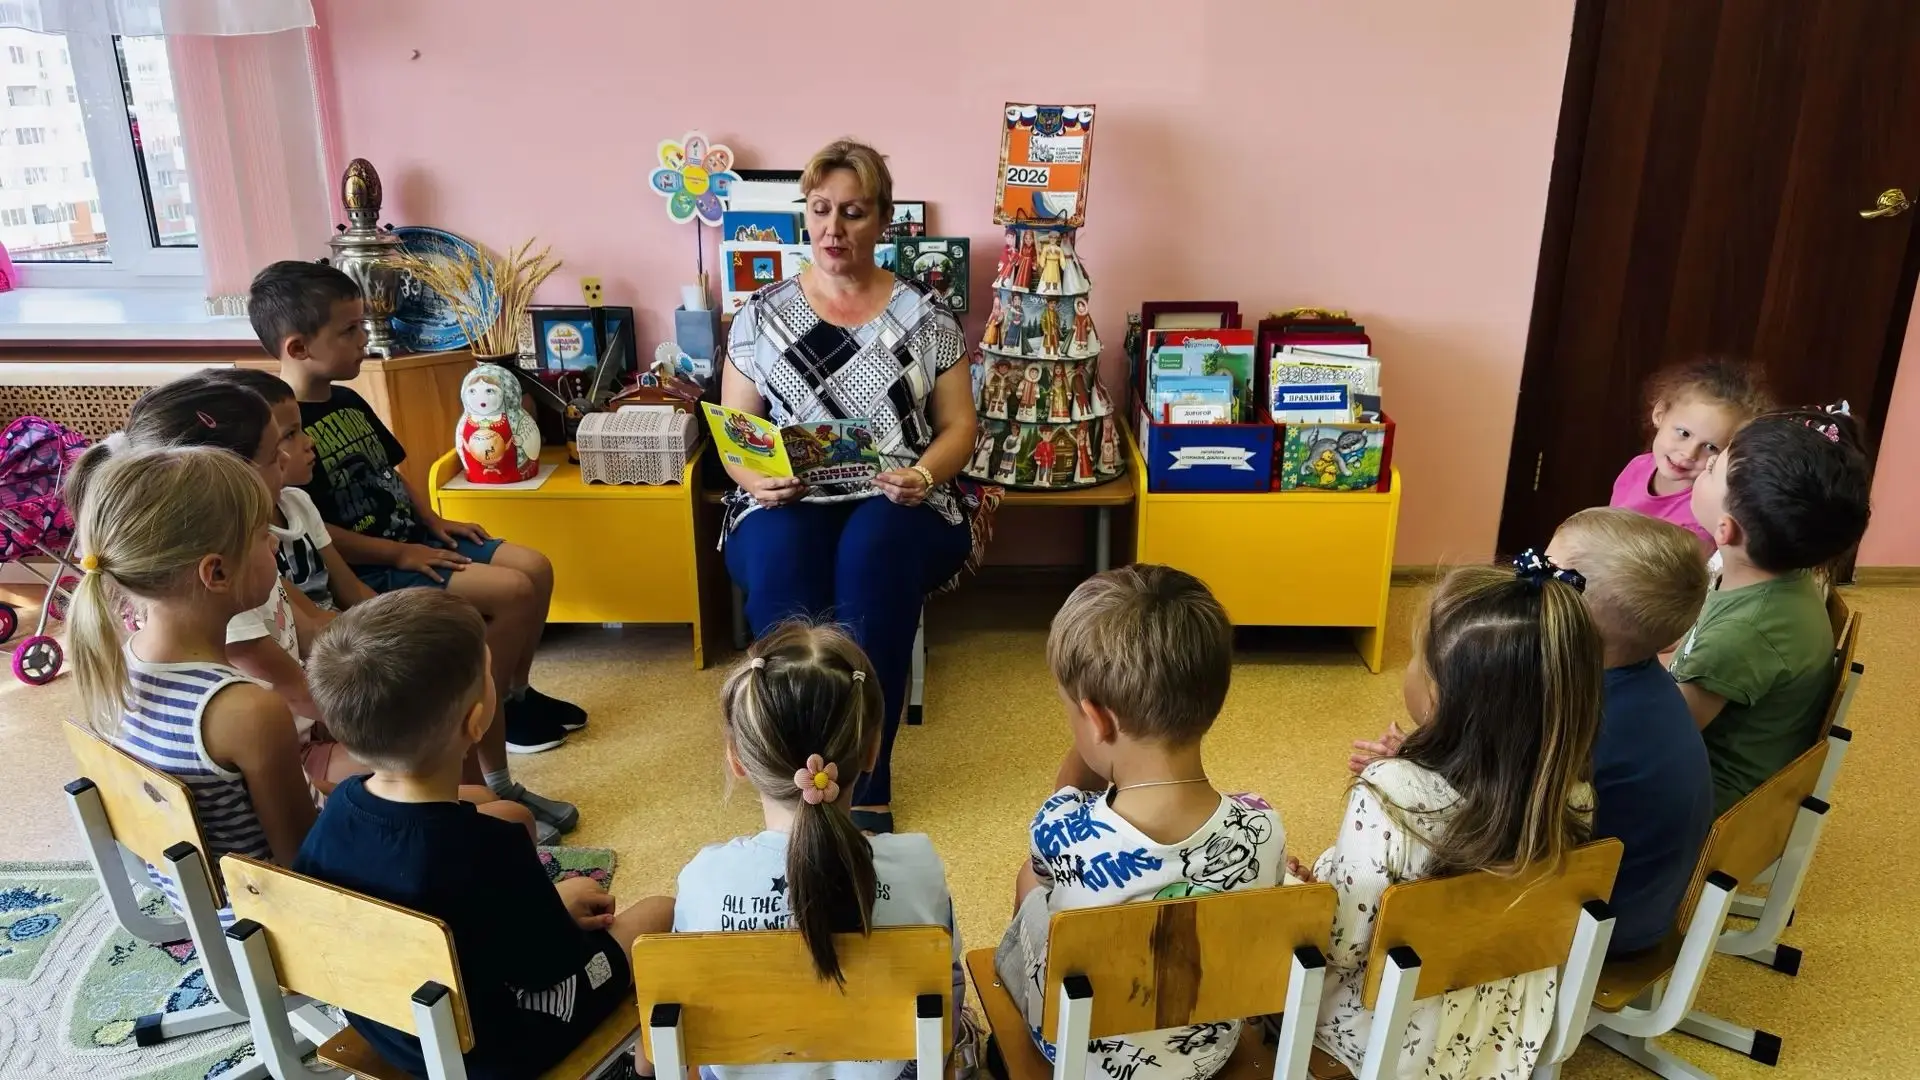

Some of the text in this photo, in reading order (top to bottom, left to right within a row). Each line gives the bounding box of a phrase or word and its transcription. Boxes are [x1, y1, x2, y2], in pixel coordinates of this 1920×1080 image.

[1007, 168, 1048, 183] 2026
[1289, 394, 1335, 402] ПРАЗДНИКИ
[810, 471, 869, 482] ИЗБУШКА
[722, 894, 746, 914] ALL
[751, 895, 783, 913] THE
